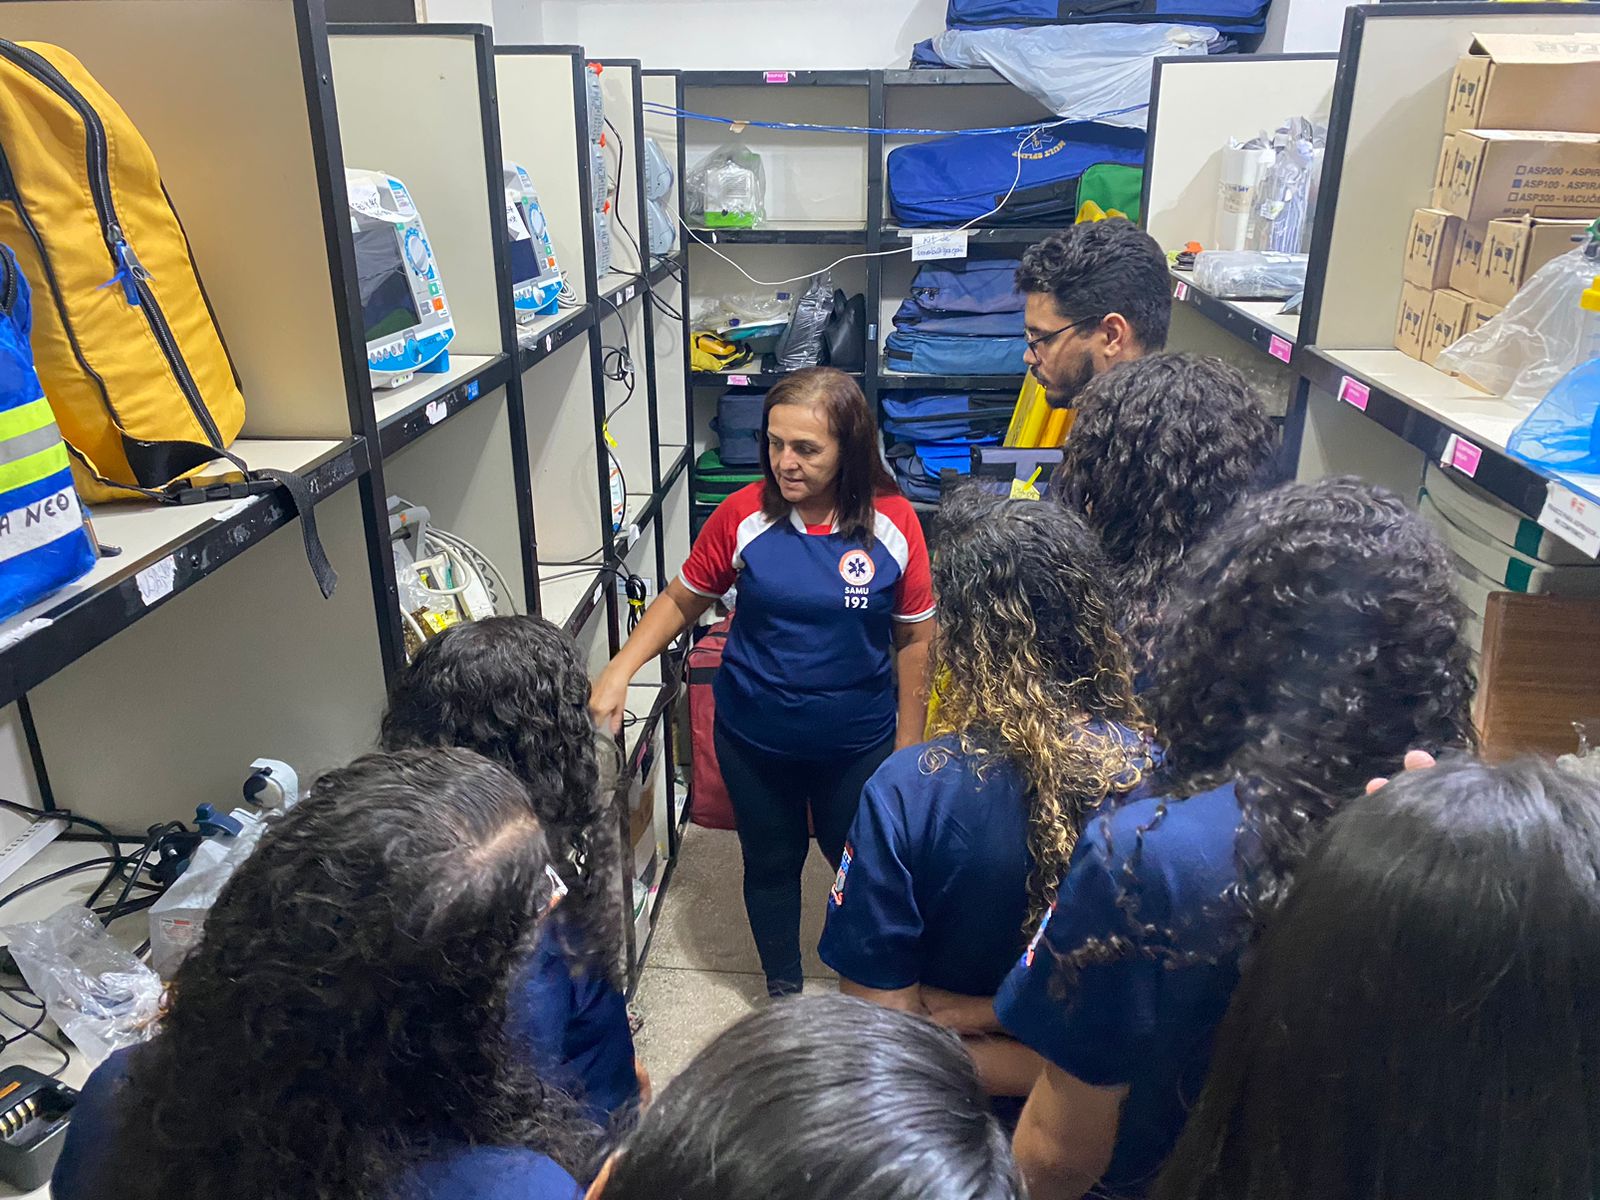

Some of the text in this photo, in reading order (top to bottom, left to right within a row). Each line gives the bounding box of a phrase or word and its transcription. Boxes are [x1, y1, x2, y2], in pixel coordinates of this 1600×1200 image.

[1527, 166, 1564, 175] ASP200
[1523, 180, 1560, 189] ASP100
[25, 493, 69, 527] NEO
[844, 586, 869, 595] SAMU
[844, 596, 868, 609] 192
